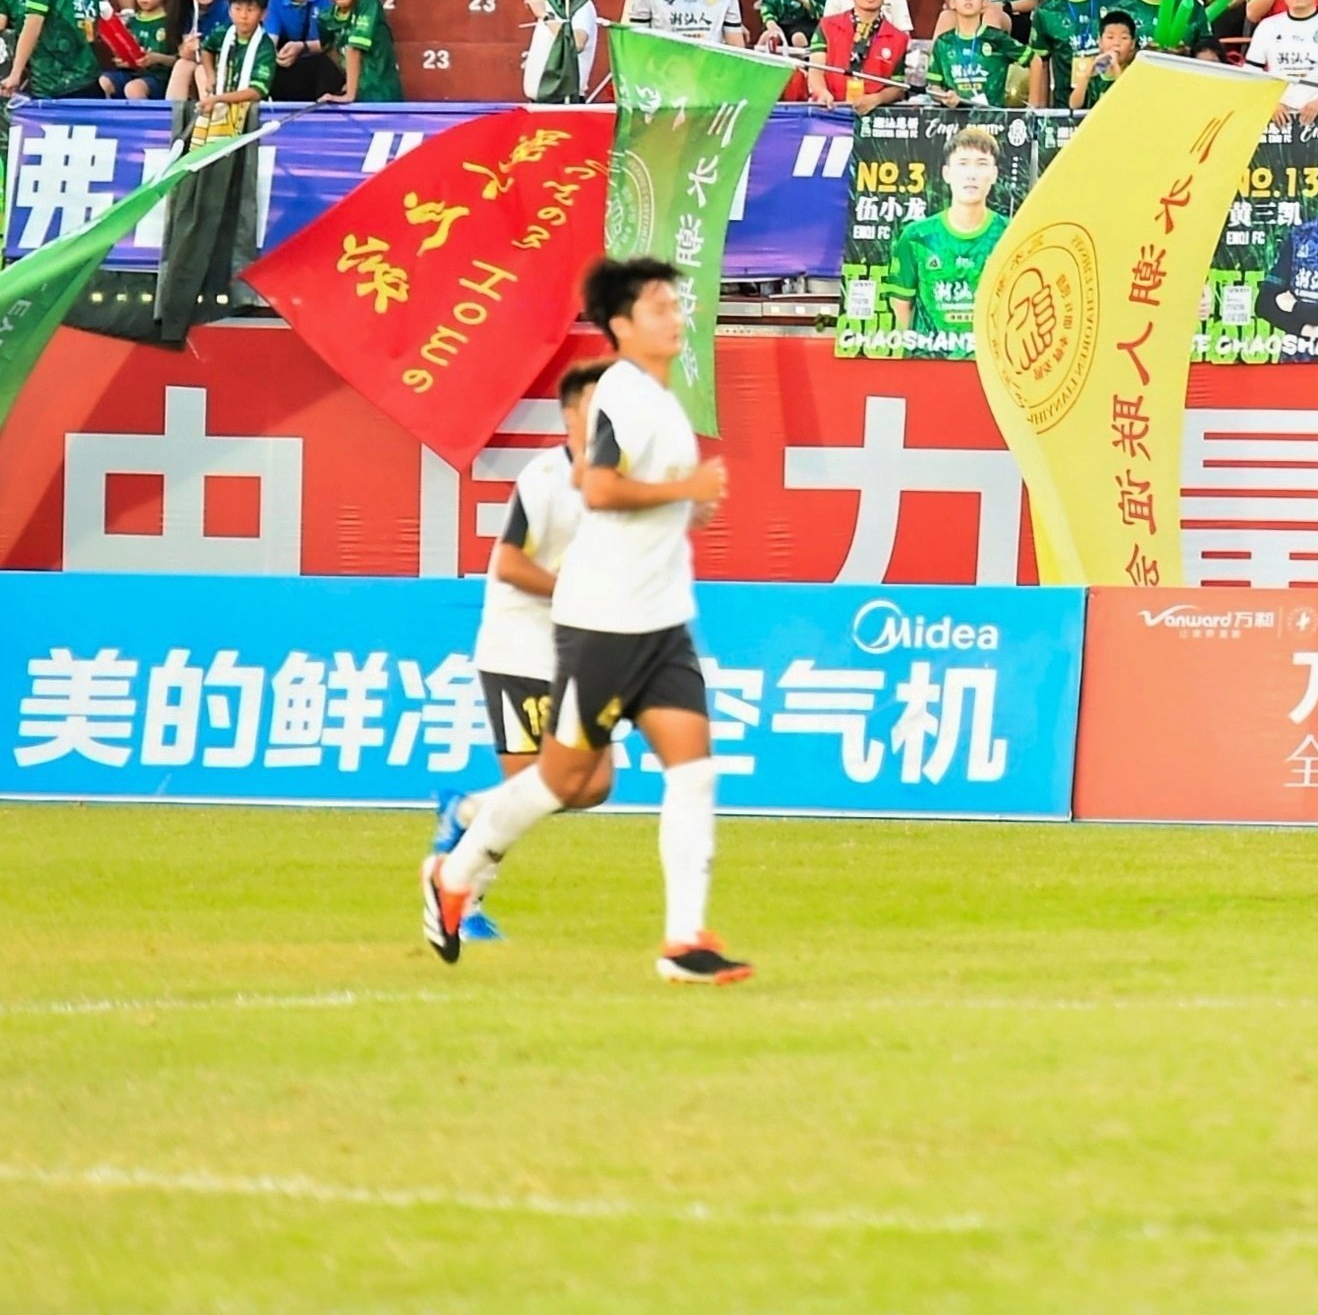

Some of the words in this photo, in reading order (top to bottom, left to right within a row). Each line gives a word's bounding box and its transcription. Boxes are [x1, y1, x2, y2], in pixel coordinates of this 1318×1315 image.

[872, 611, 1000, 652] Midea
[1138, 604, 1232, 629] Vanward
[15, 647, 1008, 785] 美的鲜净空气机
